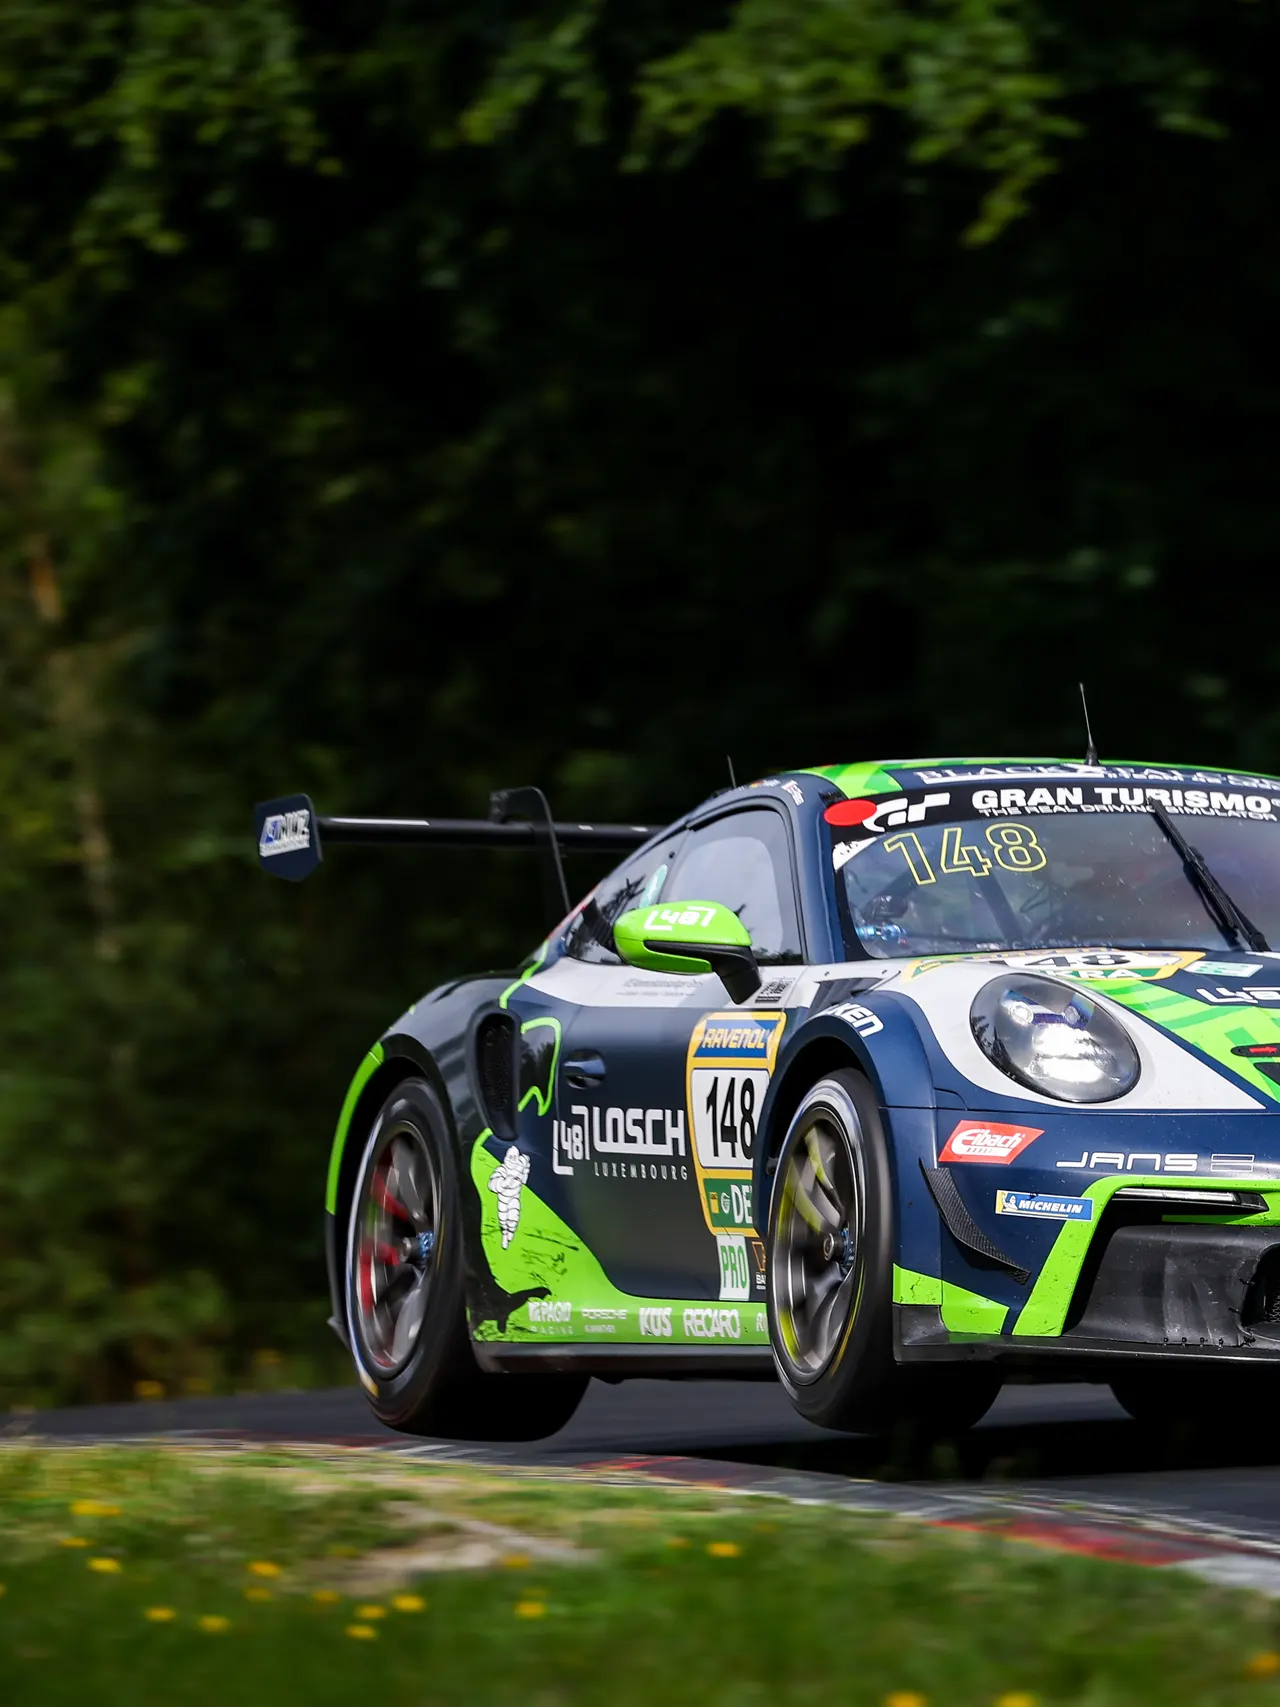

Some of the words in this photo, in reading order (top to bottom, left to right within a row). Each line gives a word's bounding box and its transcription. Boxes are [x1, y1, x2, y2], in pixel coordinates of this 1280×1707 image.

[972, 787, 1083, 810] GRAN
[979, 806, 1022, 817] THE
[1025, 805, 1079, 815] REAL
[1165, 805, 1278, 822] SIMULATOR
[883, 823, 1047, 885] 148
[1046, 968, 1143, 979] KRA
[702, 1028, 766, 1049] RAVENOL
[706, 1076, 756, 1160] 148
[593, 1106, 686, 1157] LOSCH
[951, 1128, 1025, 1157] Eibach
[593, 1161, 688, 1180] LUXEMBOURG
[1056, 1151, 1197, 1171] JANS
[1018, 1199, 1083, 1214] MICHELIN
[720, 1245, 748, 1289] PRO
[683, 1308, 740, 1339] RECARO
